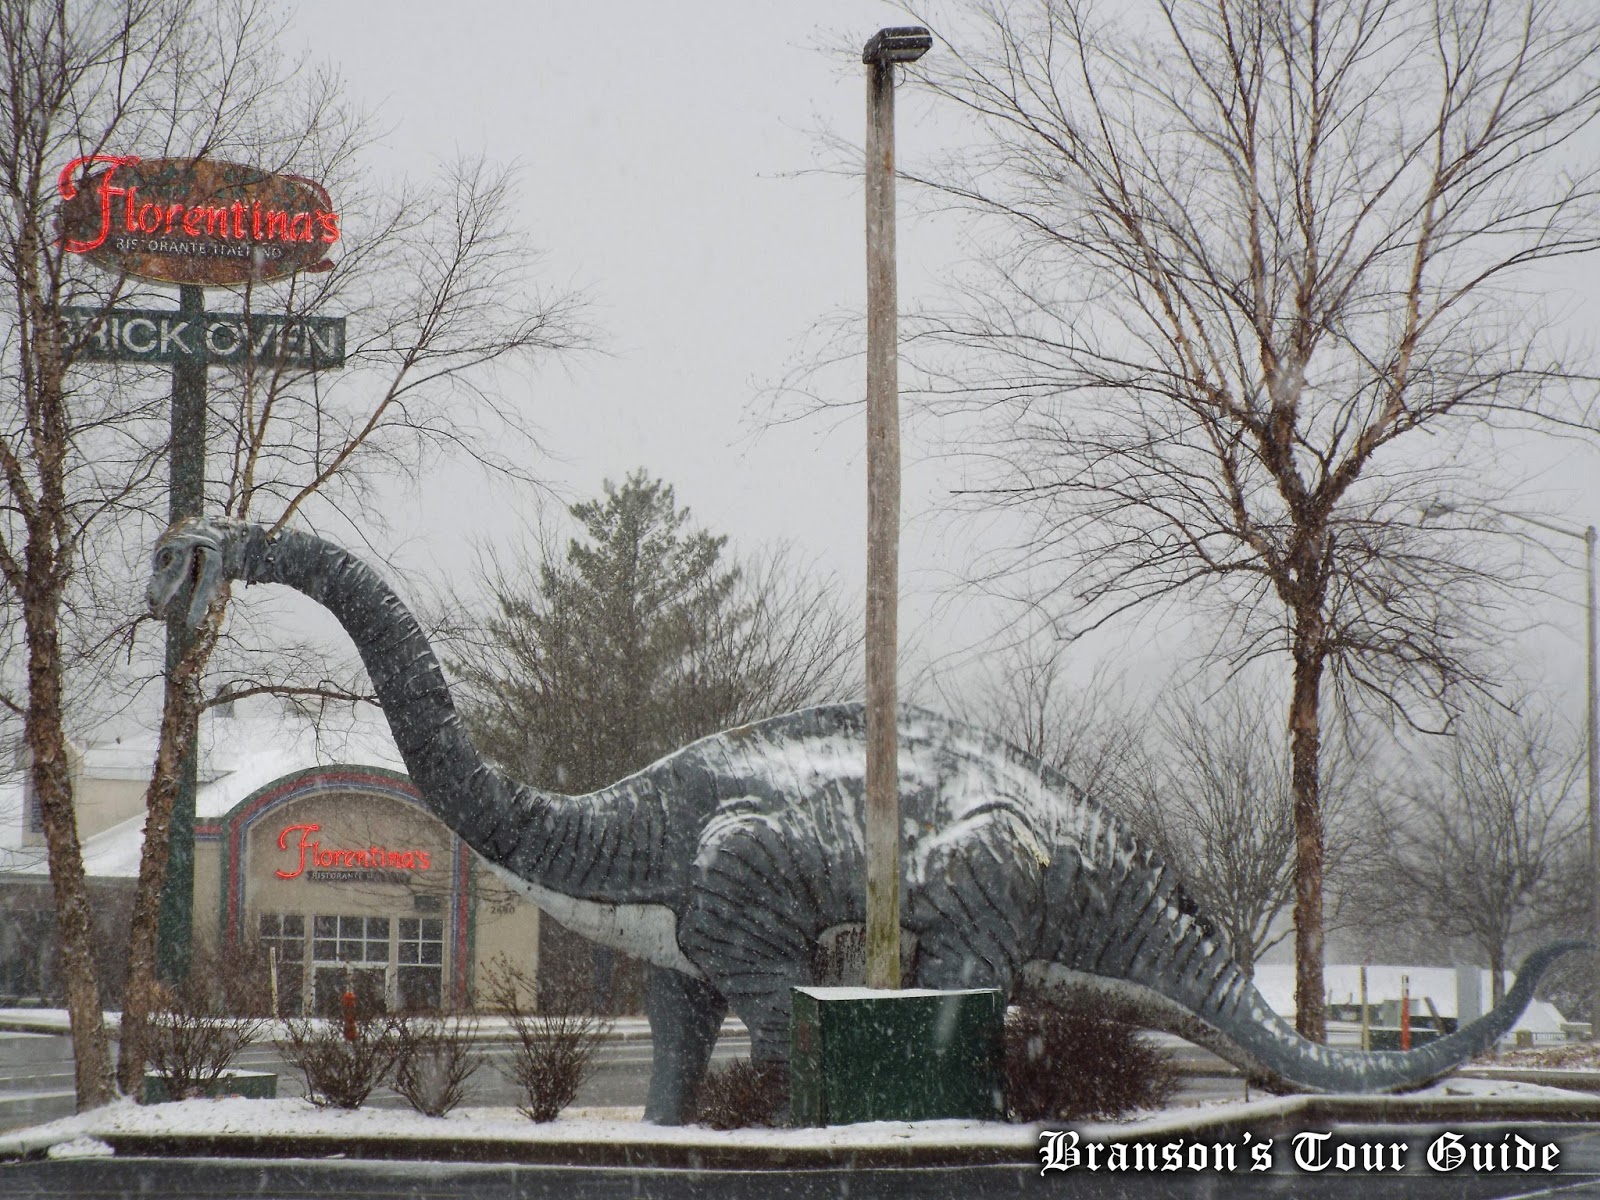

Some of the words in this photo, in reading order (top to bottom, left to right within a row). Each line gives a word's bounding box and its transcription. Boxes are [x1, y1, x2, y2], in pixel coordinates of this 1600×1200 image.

[56, 155, 341, 254] Florentina's
[213, 244, 282, 259] ITALINO
[275, 824, 431, 880] Florentina's
